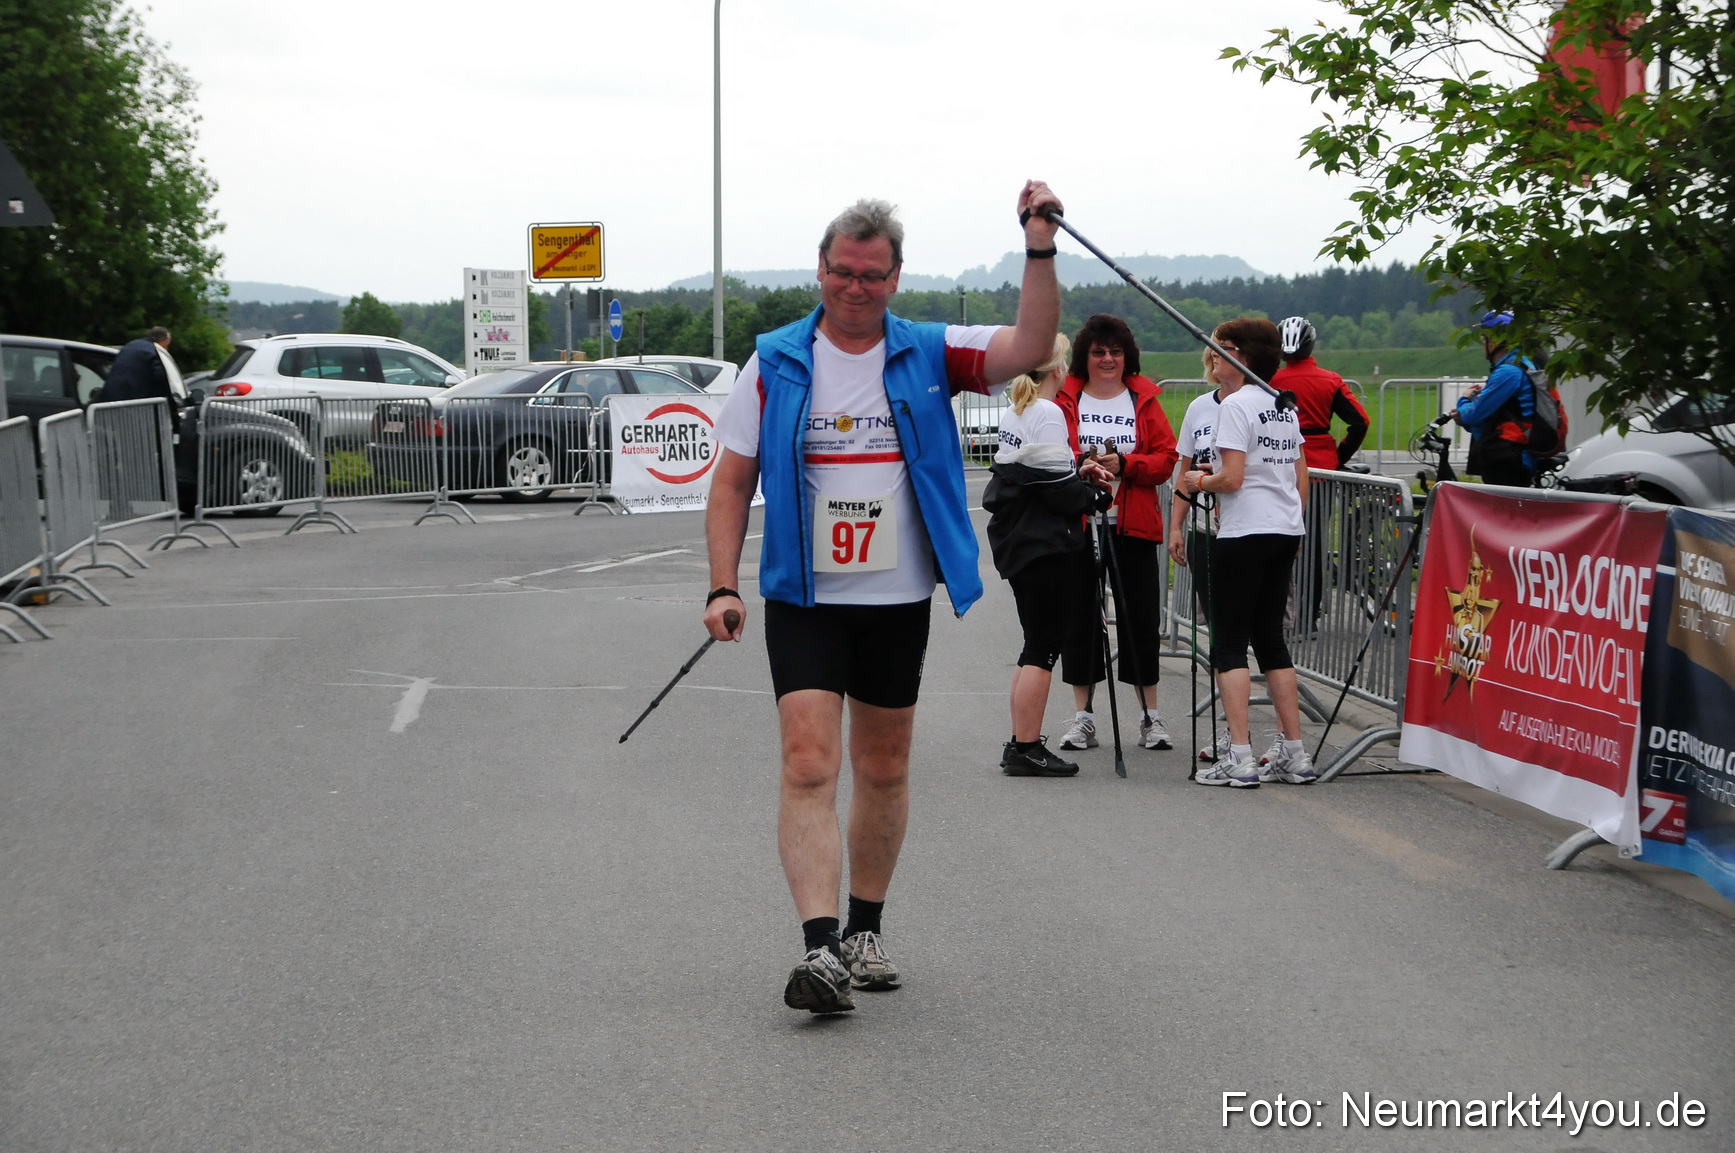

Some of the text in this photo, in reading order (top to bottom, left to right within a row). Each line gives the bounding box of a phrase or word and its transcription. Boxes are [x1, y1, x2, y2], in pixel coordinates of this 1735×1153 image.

[537, 233, 595, 250] Sengenthal
[1078, 414, 1135, 427] ERGER
[621, 423, 707, 444] GERHART &
[621, 442, 710, 462] Autohaus JÄNIG
[620, 494, 655, 508] Neumarkt
[661, 493, 703, 509] Sengenthal
[828, 500, 866, 511] MEYER
[828, 510, 866, 518] WERBUNG
[832, 521, 876, 564] 97
[1641, 794, 1674, 833] 7
